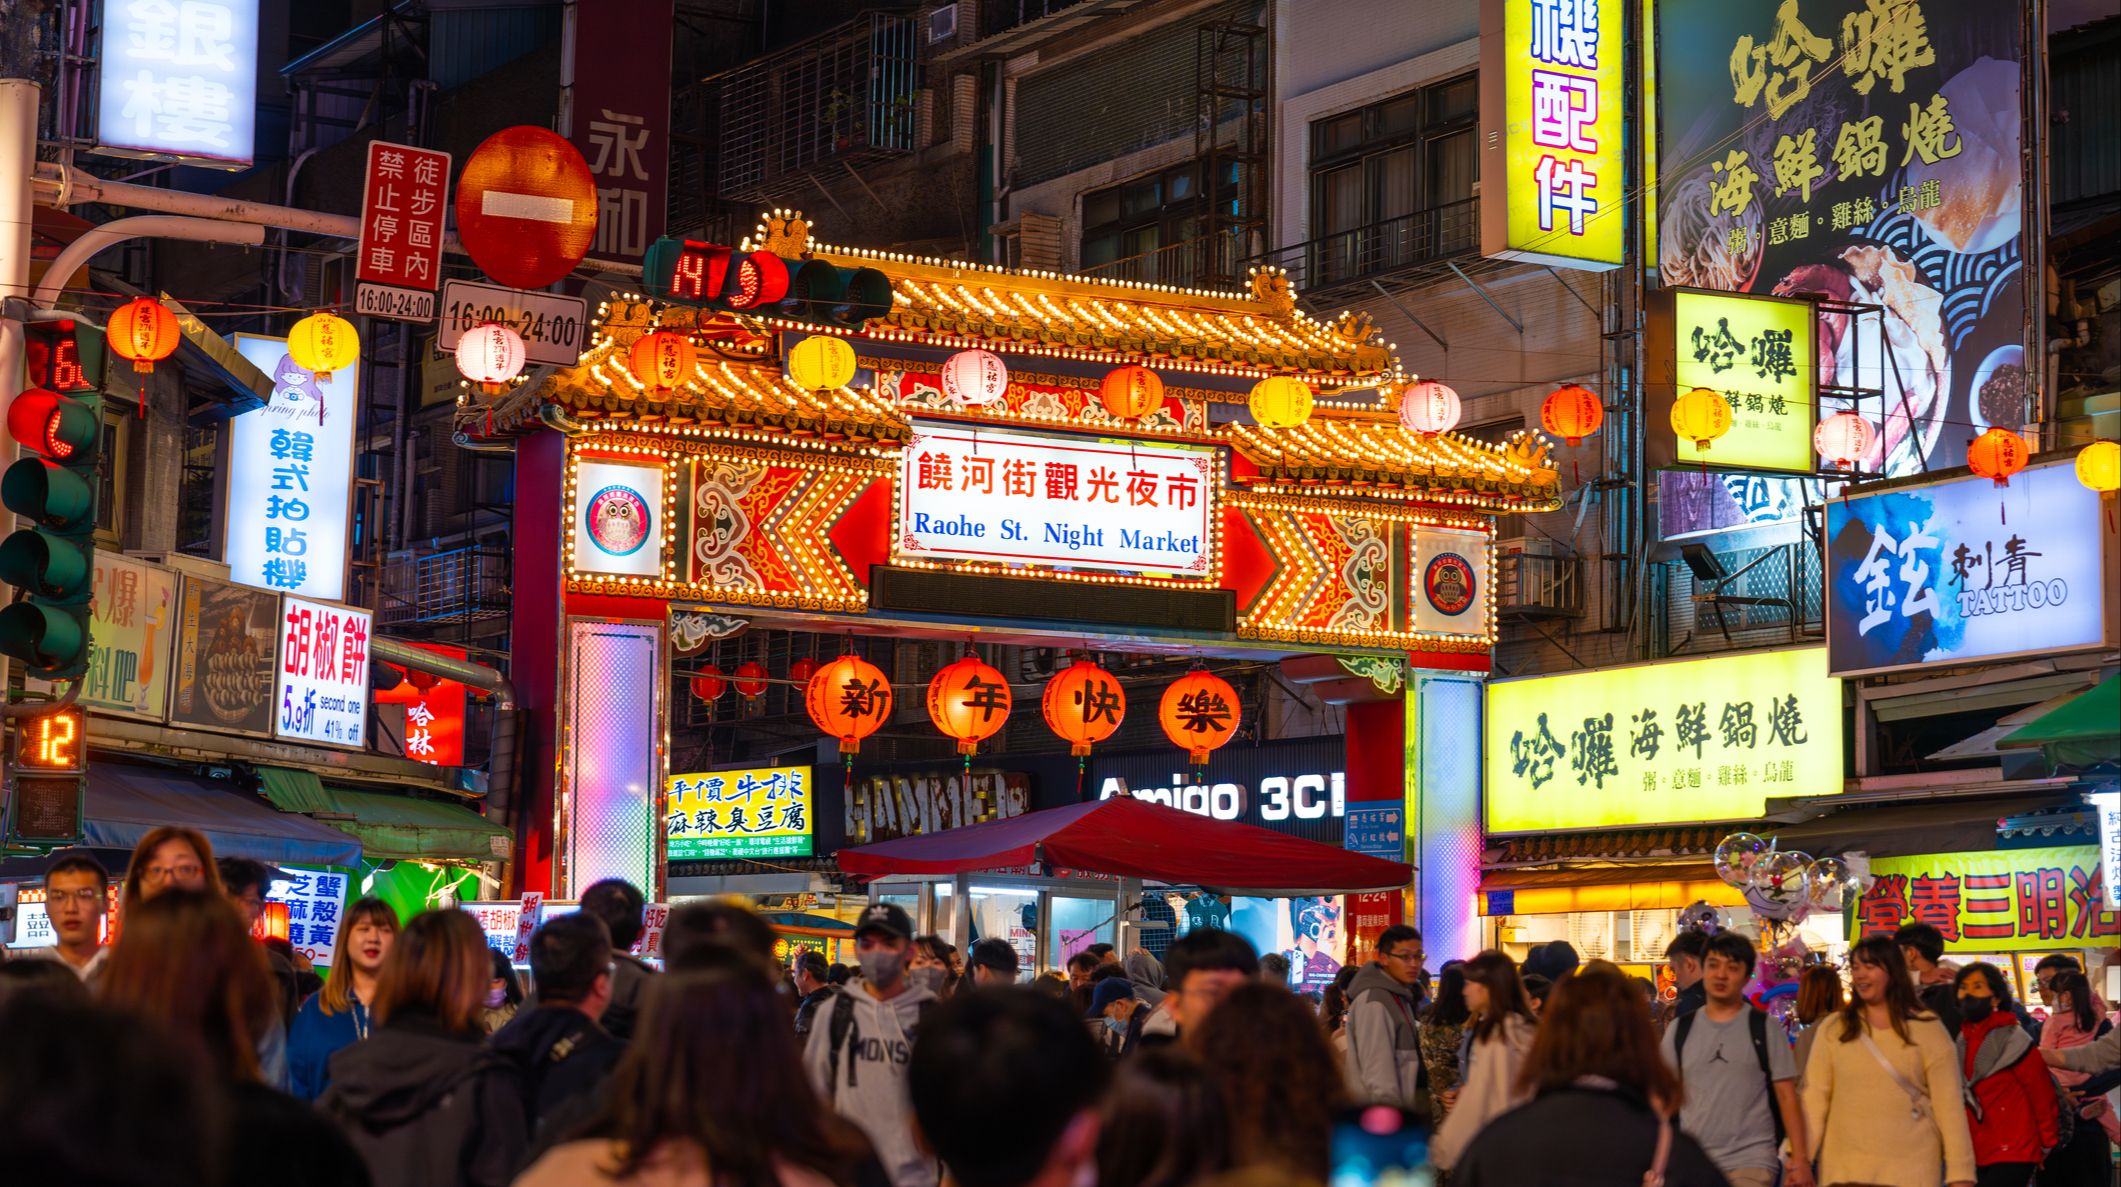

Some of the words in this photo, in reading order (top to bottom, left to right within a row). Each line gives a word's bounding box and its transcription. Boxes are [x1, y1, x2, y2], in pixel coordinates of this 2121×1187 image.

[121, 0, 236, 148] 銀樓
[1530, 0, 1599, 237] 機配件
[589, 108, 651, 258] 永和
[1708, 93, 1963, 217] 海鮮鍋燒
[368, 150, 405, 275] 禁止停車
[403, 155, 440, 281] 徒步區內
[359, 288, 432, 319] 16:00-24:00
[449, 301, 577, 347] 16:00~24:00
[1724, 389, 1789, 416] 鮮鍋燒
[261, 428, 315, 590] 韓式拍貼機
[917, 450, 1199, 511] 饒河街觀光夜市
[913, 512, 986, 538] Raohe
[1000, 518, 1029, 541] St.
[1044, 522, 1104, 550] Night
[1119, 528, 1199, 554] Market
[1948, 533, 2043, 590] 刺青
[1956, 577, 2068, 619] TATTOO
[284, 603, 367, 687] 胡椒餅
[282, 684, 316, 735] 5.9折
[319, 694, 346, 713] second
[347, 699, 361, 715] one
[324, 719, 343, 740] 41%
[347, 723, 360, 742] off
[406, 701, 438, 765] 哈林
[840, 677, 889, 723] 新
[962, 674, 1008, 723] 年
[1073, 678, 1121, 724] 快
[1175, 688, 1232, 733] 樂
[41, 715, 74, 764] 12
[668, 770, 804, 803] 平價牛排
[668, 801, 806, 836] 麻辣臭豆腐
[307, 875, 342, 947] 蟹殼黃
[1858, 863, 2121, 944] 營養三明治
